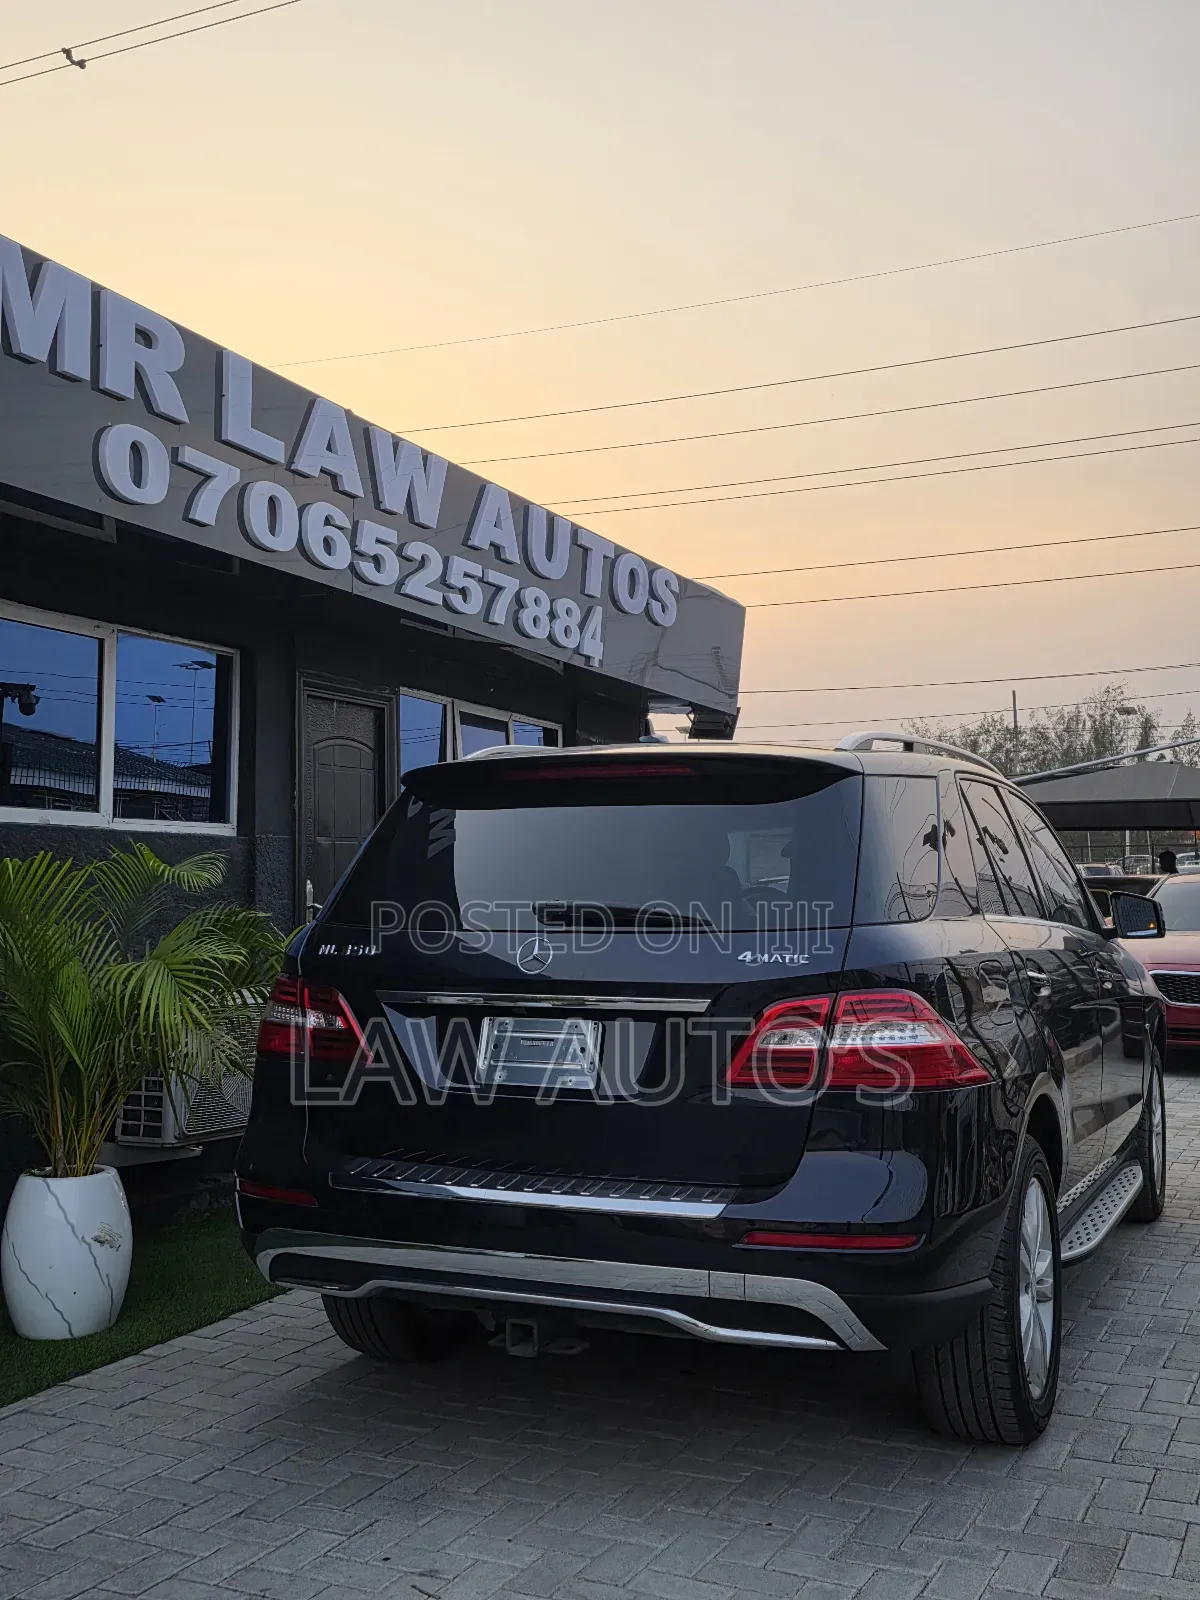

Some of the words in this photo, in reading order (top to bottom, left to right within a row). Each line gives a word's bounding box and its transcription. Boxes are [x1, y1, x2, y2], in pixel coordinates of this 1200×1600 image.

[0, 236, 190, 424] MR
[215, 348, 448, 529] LAW
[462, 483, 680, 627] AUTOS
[92, 422, 604, 667] 07065257884
[737, 950, 810, 964] 4MATIC
